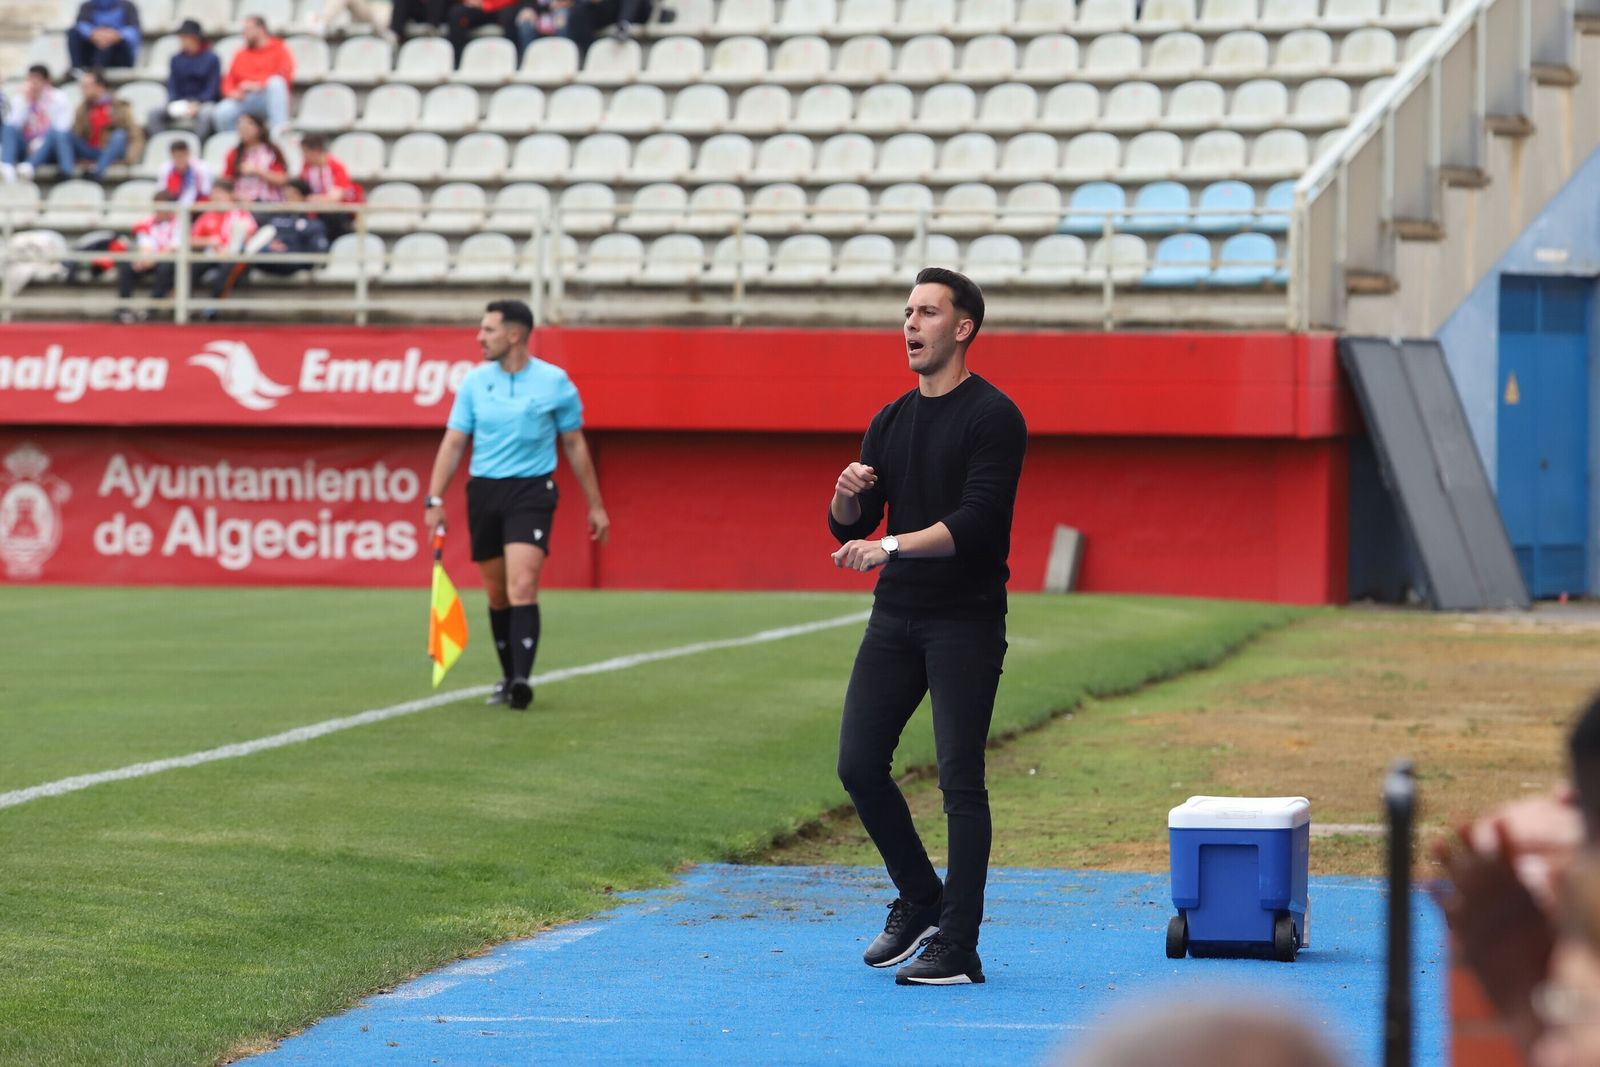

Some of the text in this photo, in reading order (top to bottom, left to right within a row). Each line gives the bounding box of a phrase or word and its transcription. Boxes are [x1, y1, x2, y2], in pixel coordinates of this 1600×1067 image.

[98, 453, 419, 508] Ayuntamiento
[94, 505, 418, 570] de Algeciras
